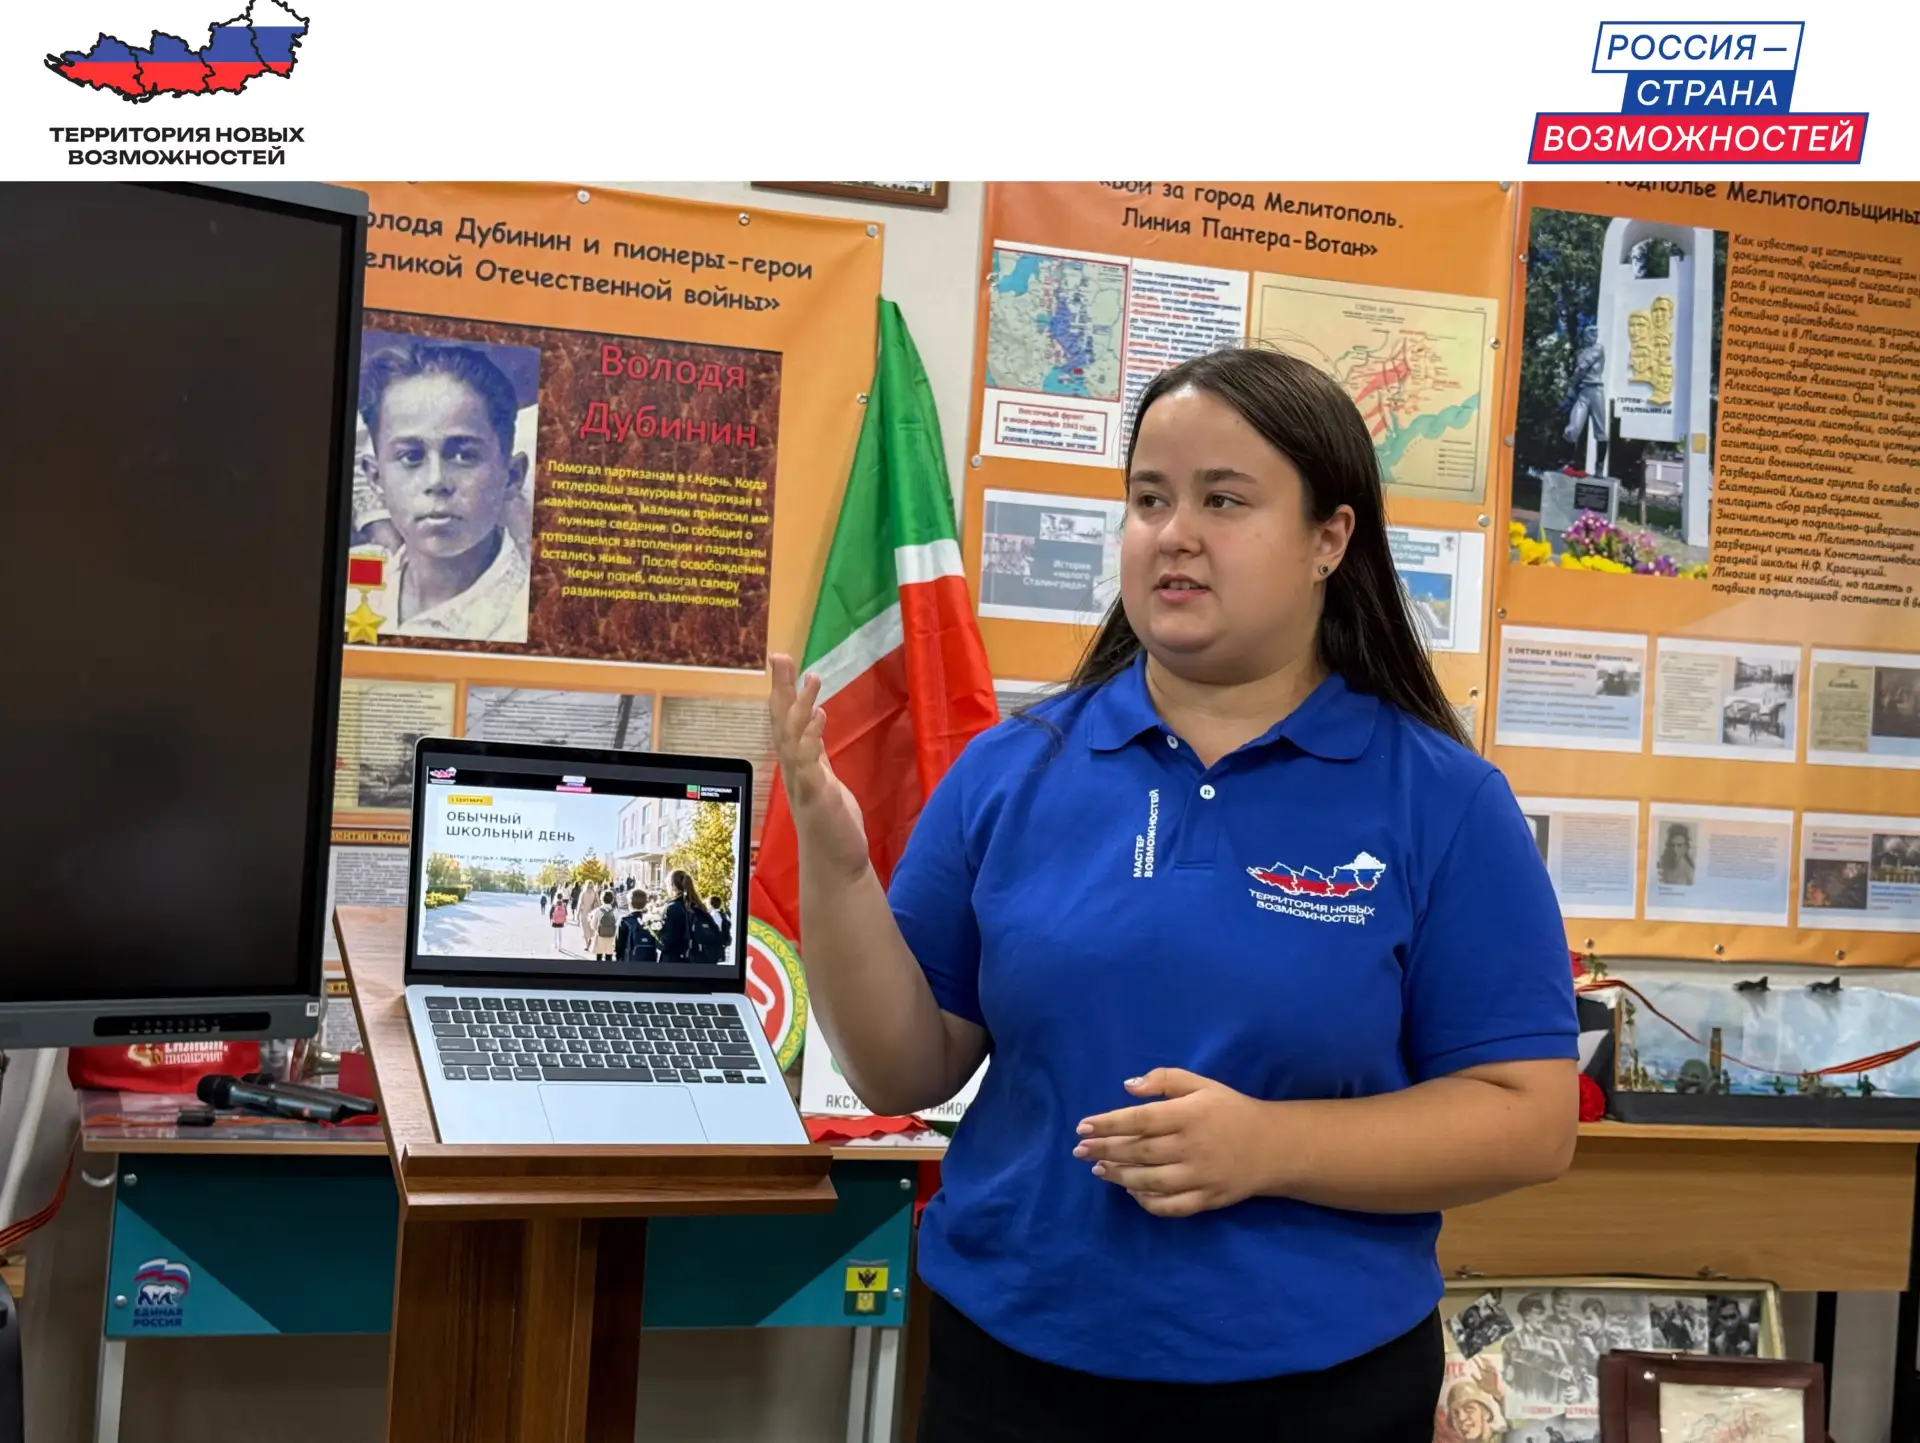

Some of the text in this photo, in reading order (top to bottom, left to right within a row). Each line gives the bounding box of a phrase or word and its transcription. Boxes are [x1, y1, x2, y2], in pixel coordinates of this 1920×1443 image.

[1162, 183, 1184, 200] за
[1196, 187, 1255, 211] город
[1265, 191, 1404, 228] Мелитополь.
[1122, 208, 1378, 257] Линия Пантера-Вотан»
[456, 217, 571, 252] Дубинин
[584, 237, 600, 255] и
[614, 240, 813, 280] пионеры-герои
[1733, 235, 1752, 246] Как
[1756, 239, 1808, 252] известно
[1826, 248, 1901, 263] исторических
[1732, 252, 1916, 279] документов, действия партизан
[476, 258, 672, 301] Отечественной
[685, 286, 780, 312] войны»
[1731, 266, 1903, 293] работа подпольщиков сыграли
[1730, 281, 1910, 308] роль успешном исходе Великой
[1730, 293, 1858, 316] Отечественной войны.
[1729, 307, 1853, 330] Активно действовало
[1728, 324, 1778, 336] подполье
[1799, 329, 1874, 346] Мелитополе.
[1727, 338, 1784, 351] оккупации
[1797, 346, 1834, 357] городе
[1837, 350, 1875, 361] начали
[601, 344, 745, 393] Володя
[1726, 352, 1907, 379] подпольно-диверсионные группы
[1725, 367, 1807, 383] руководством
[1809, 374, 1874, 391] Александра
[1724, 378, 1789, 396] Александра
[1793, 386, 1847, 401] Костенко.
[1852, 392, 1873, 404] Они
[1886, 398, 1917, 409] очень
[1723, 396, 1773, 408] сложных
[1777, 401, 1825, 413] условиях
[1829, 406, 1888, 420] совершали
[580, 401, 757, 448] Дубинин
[1722, 410, 1873, 435] распространяли листовки,
[1722, 422, 1879, 448] Совинформбюро, проводили
[1719, 453, 1854, 474] спасали военнопленных.
[1720, 439, 1882, 465] агитацию, собирали оружие,
[548, 461, 600, 474] Помогал
[604, 468, 674, 481] партизанам
[734, 477, 767, 489] Когда
[1719, 464, 1823, 485] Разведывательная
[1826, 478, 1863, 489] группа
[1882, 483, 1911, 494] главе
[552, 481, 753, 505] гитлеровцы замуровали партизан
[1718, 479, 1919, 510] Екатериной Хилько сумела активно
[693, 509, 747, 521] приносил
[1716, 496, 1883, 520] наладить сбор разведданных.
[1716, 507, 1797, 527] Значительную
[558, 516, 606, 527] нужные
[691, 526, 742, 538] сообщил
[1715, 525, 1795, 540] деятельность
[1814, 532, 1914, 552] Мелитопольщине
[539, 532, 766, 556] готовящемся затоплении партизаны
[1714, 538, 1821, 557] развернул учитель
[540, 550, 595, 561] остались
[641, 555, 677, 566] После
[680, 560, 765, 573] освобождения
[1713, 554, 1758, 566] средней
[1761, 558, 1797, 569] школы
[1801, 559, 1821, 572] Н.Ф.
[567, 568, 603, 580] Керчи
[607, 572, 644, 584] погиб,
[1712, 564, 1755, 579] Многие
[1773, 573, 1792, 583] них
[1795, 575, 1842, 590] погибли,
[1861, 582, 1902, 593] память
[562, 587, 741, 605] разминировать каменоломни.
[1711, 581, 1900, 608] подвиге подпольщиков останется
[447, 810, 522, 825] ОБЫЧНЫЙ
[446, 825, 576, 843] ШКОЛЬНЫЙ ДЕНЬ
[1144, 789, 1160, 878] ВОЗМОЖНОСТЕЙ
[1133, 834, 1144, 878] МАСТЕР
[1249, 889, 1376, 917] ТЕРРИТОРИЯ НОВЫХ
[1256, 900, 1366, 925] ВОЗМОЖНОСТЕЙ
[133, 1317, 183, 1328] РОССИЯ
